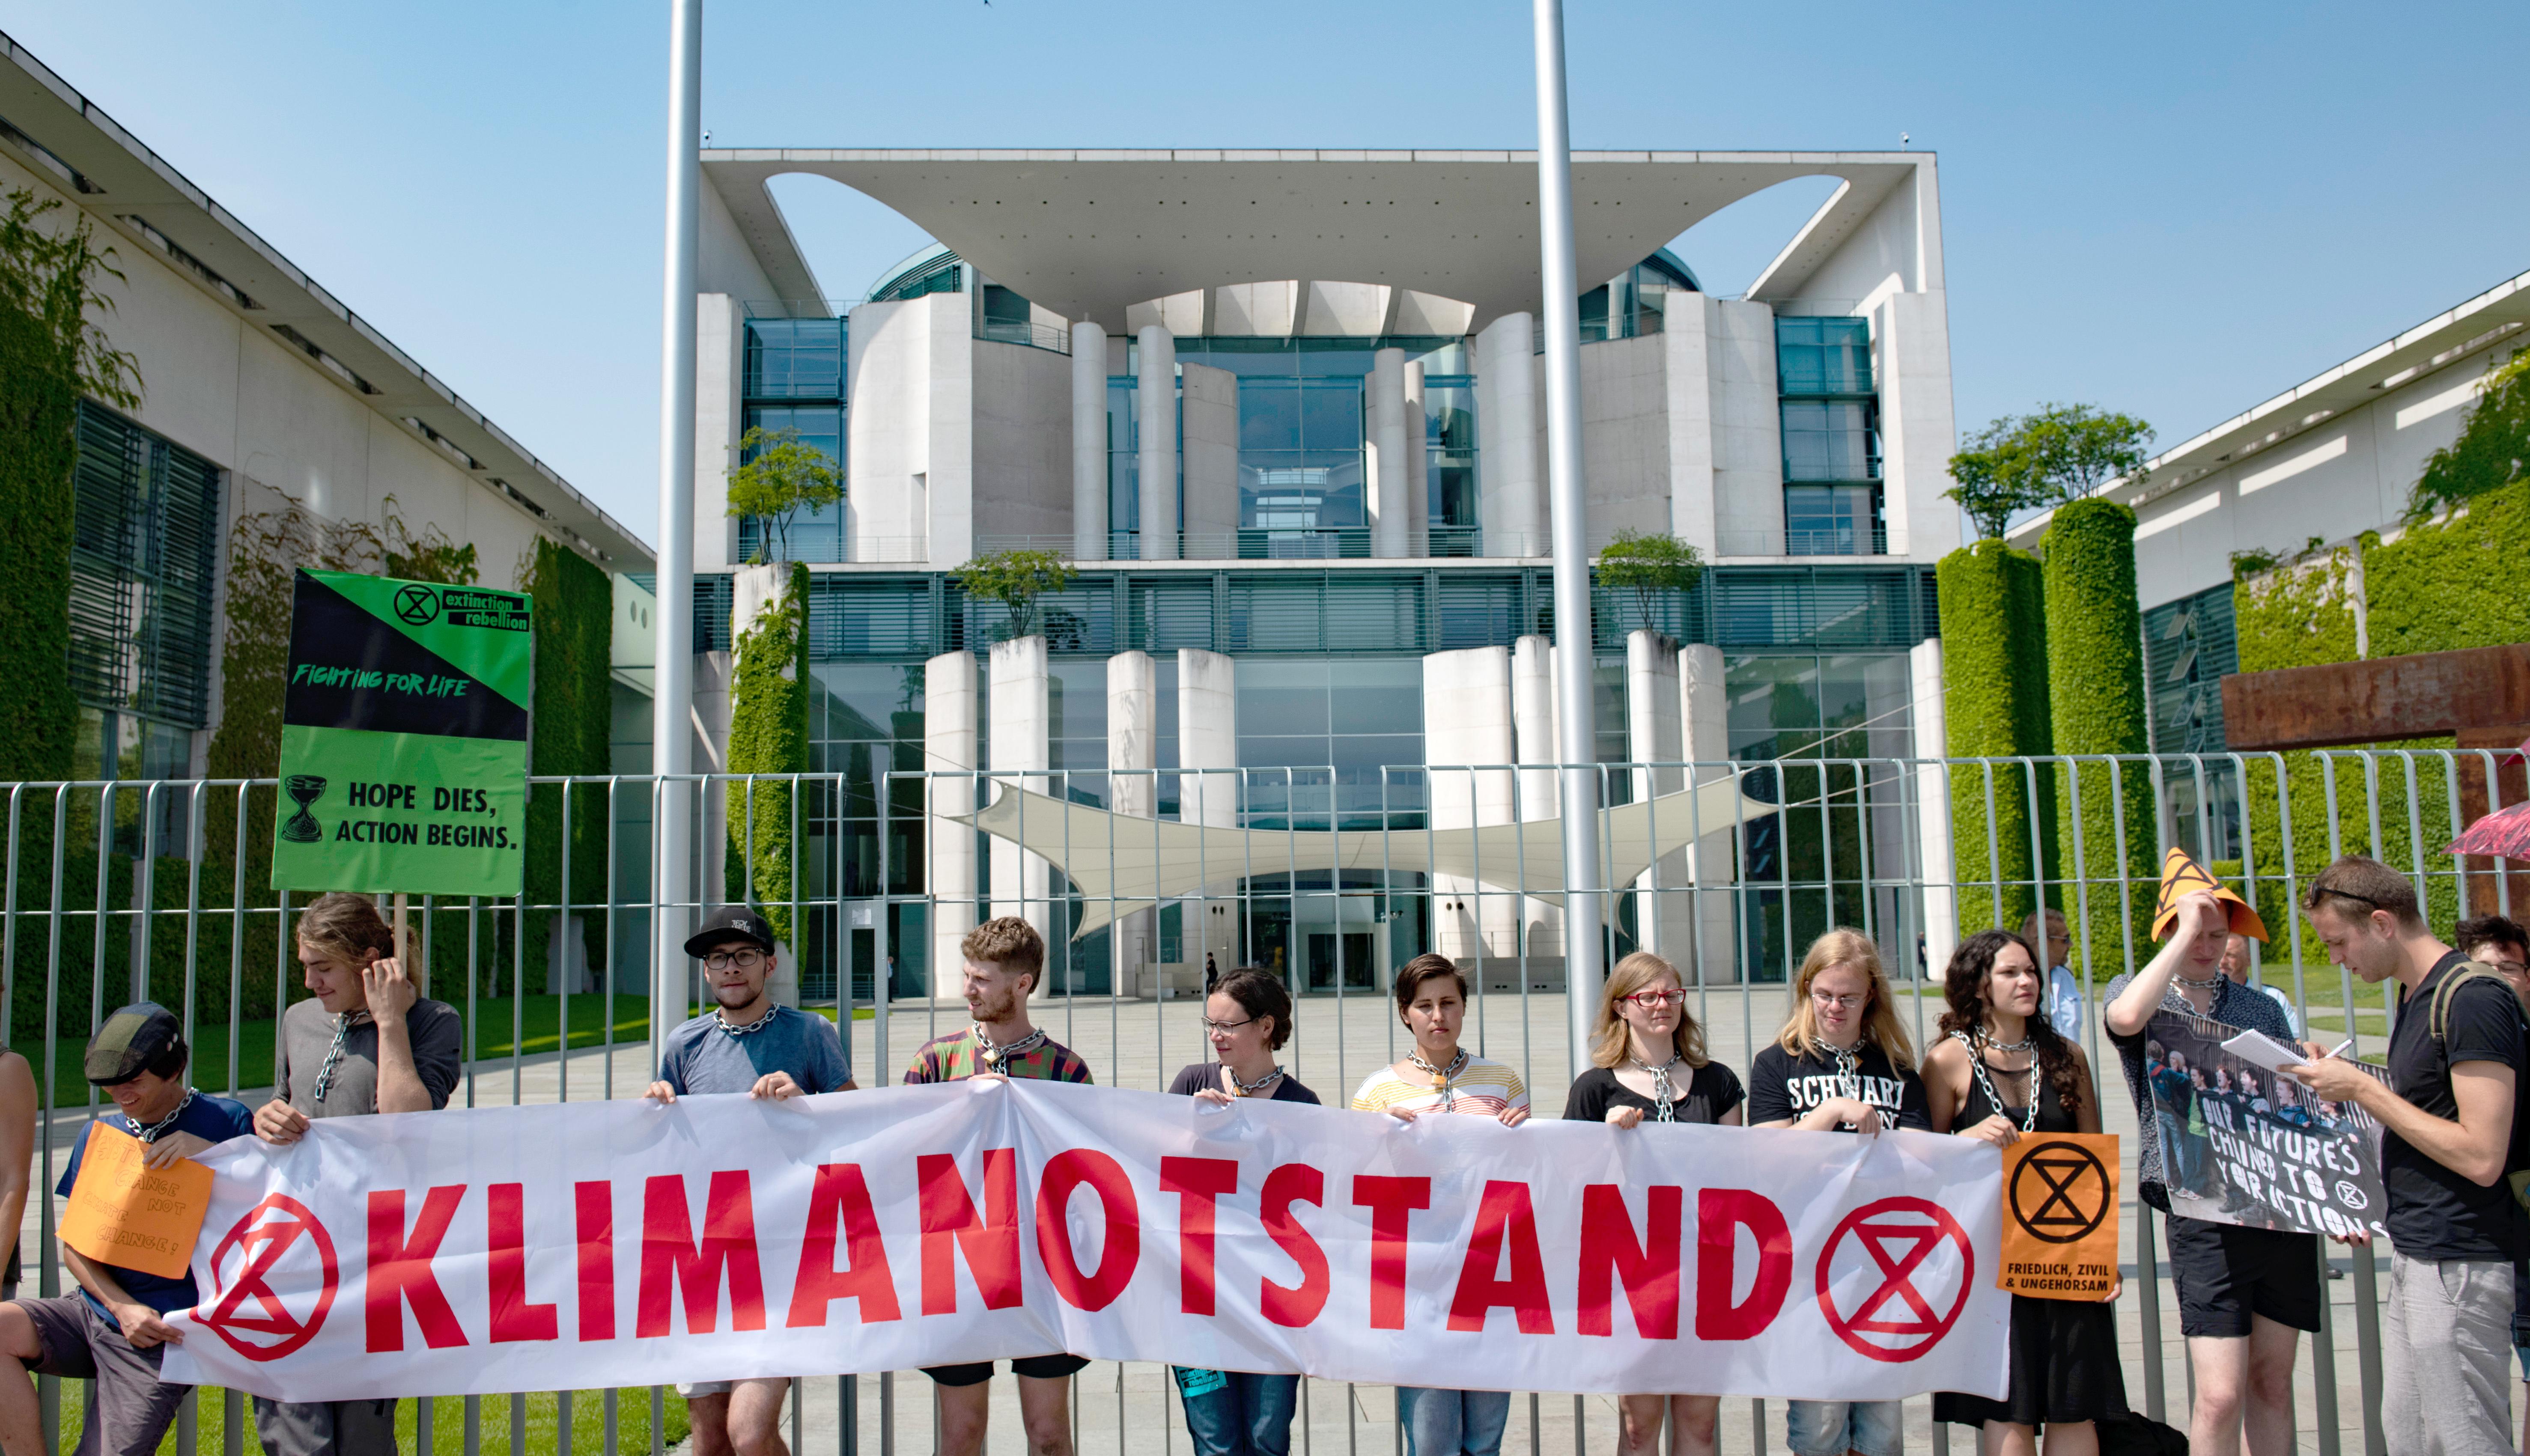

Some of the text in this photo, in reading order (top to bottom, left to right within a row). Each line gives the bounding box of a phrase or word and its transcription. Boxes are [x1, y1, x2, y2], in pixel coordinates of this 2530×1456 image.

[446, 593, 513, 610] extinction
[466, 611, 527, 630] rebellion
[385, 673, 424, 696] FOR
[349, 782, 496, 818] HOPE DIES,
[335, 820, 517, 850] ACTION BEGINS.
[2202, 1097, 2235, 1134] OUR
[97, 1136, 146, 1169] SYSTE
[115, 1170, 180, 1197] CHANGE
[2216, 1158, 2266, 1202] YOUR
[2282, 1161, 2327, 1201] TO
[82, 1191, 128, 1222] CLIMATE
[148, 1198, 186, 1216] NOT
[366, 1147, 1793, 1353] KLIMANOTSTAND
[2006, 1277, 2108, 1291] & UNGEHORSAM
[2008, 1263, 2109, 1277] FRIEDLICH, ZIVIL
[1189, 1374, 1218, 1387] rebellion
